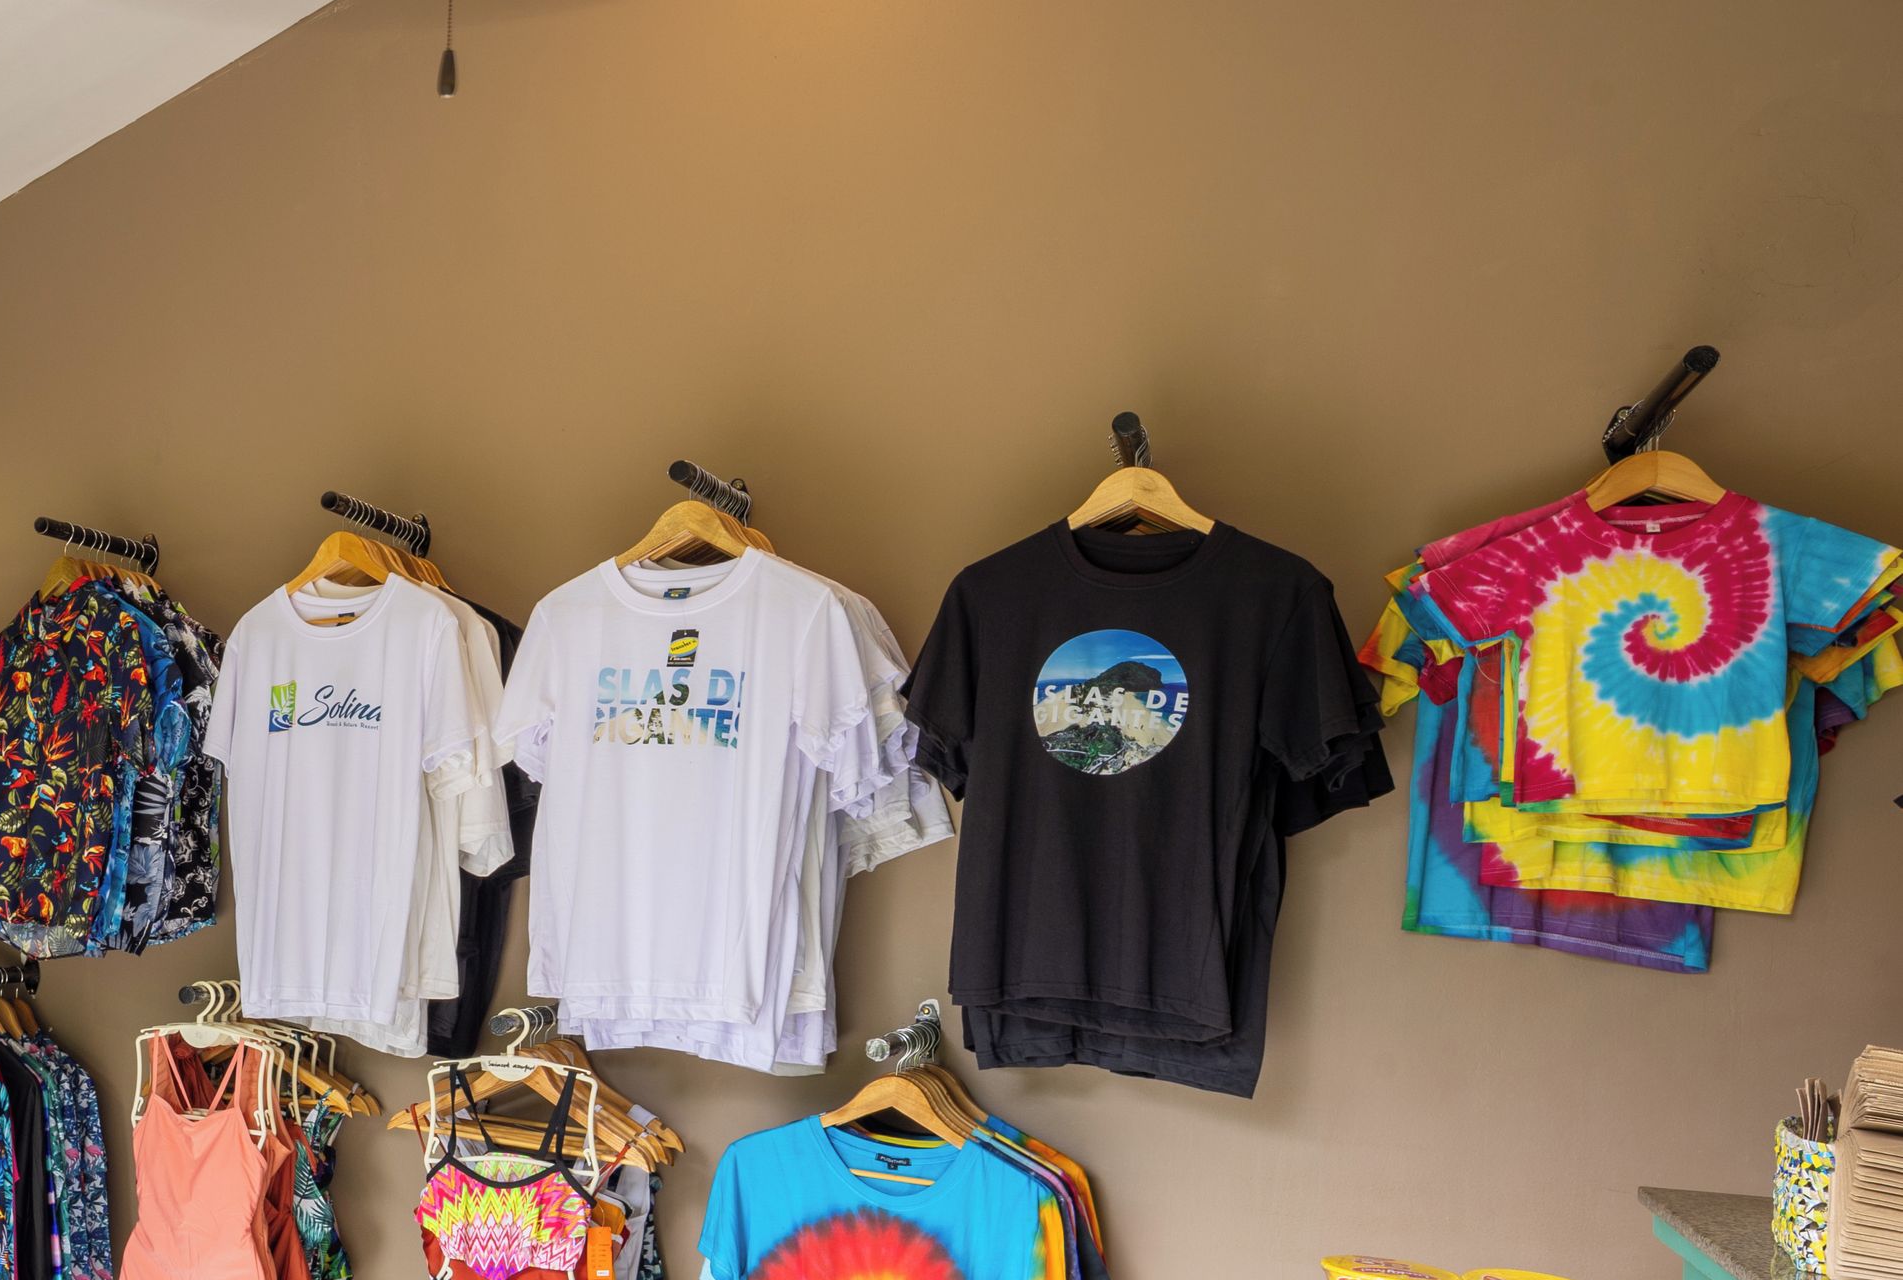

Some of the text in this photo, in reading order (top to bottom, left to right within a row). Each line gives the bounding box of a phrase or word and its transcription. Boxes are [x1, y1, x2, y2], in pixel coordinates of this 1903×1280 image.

[597, 667, 691, 706] SLAS
[1033, 684, 1189, 713] ISLAS DE
[297, 685, 382, 726] Solina
[1034, 705, 1184, 732] GIGANTES
